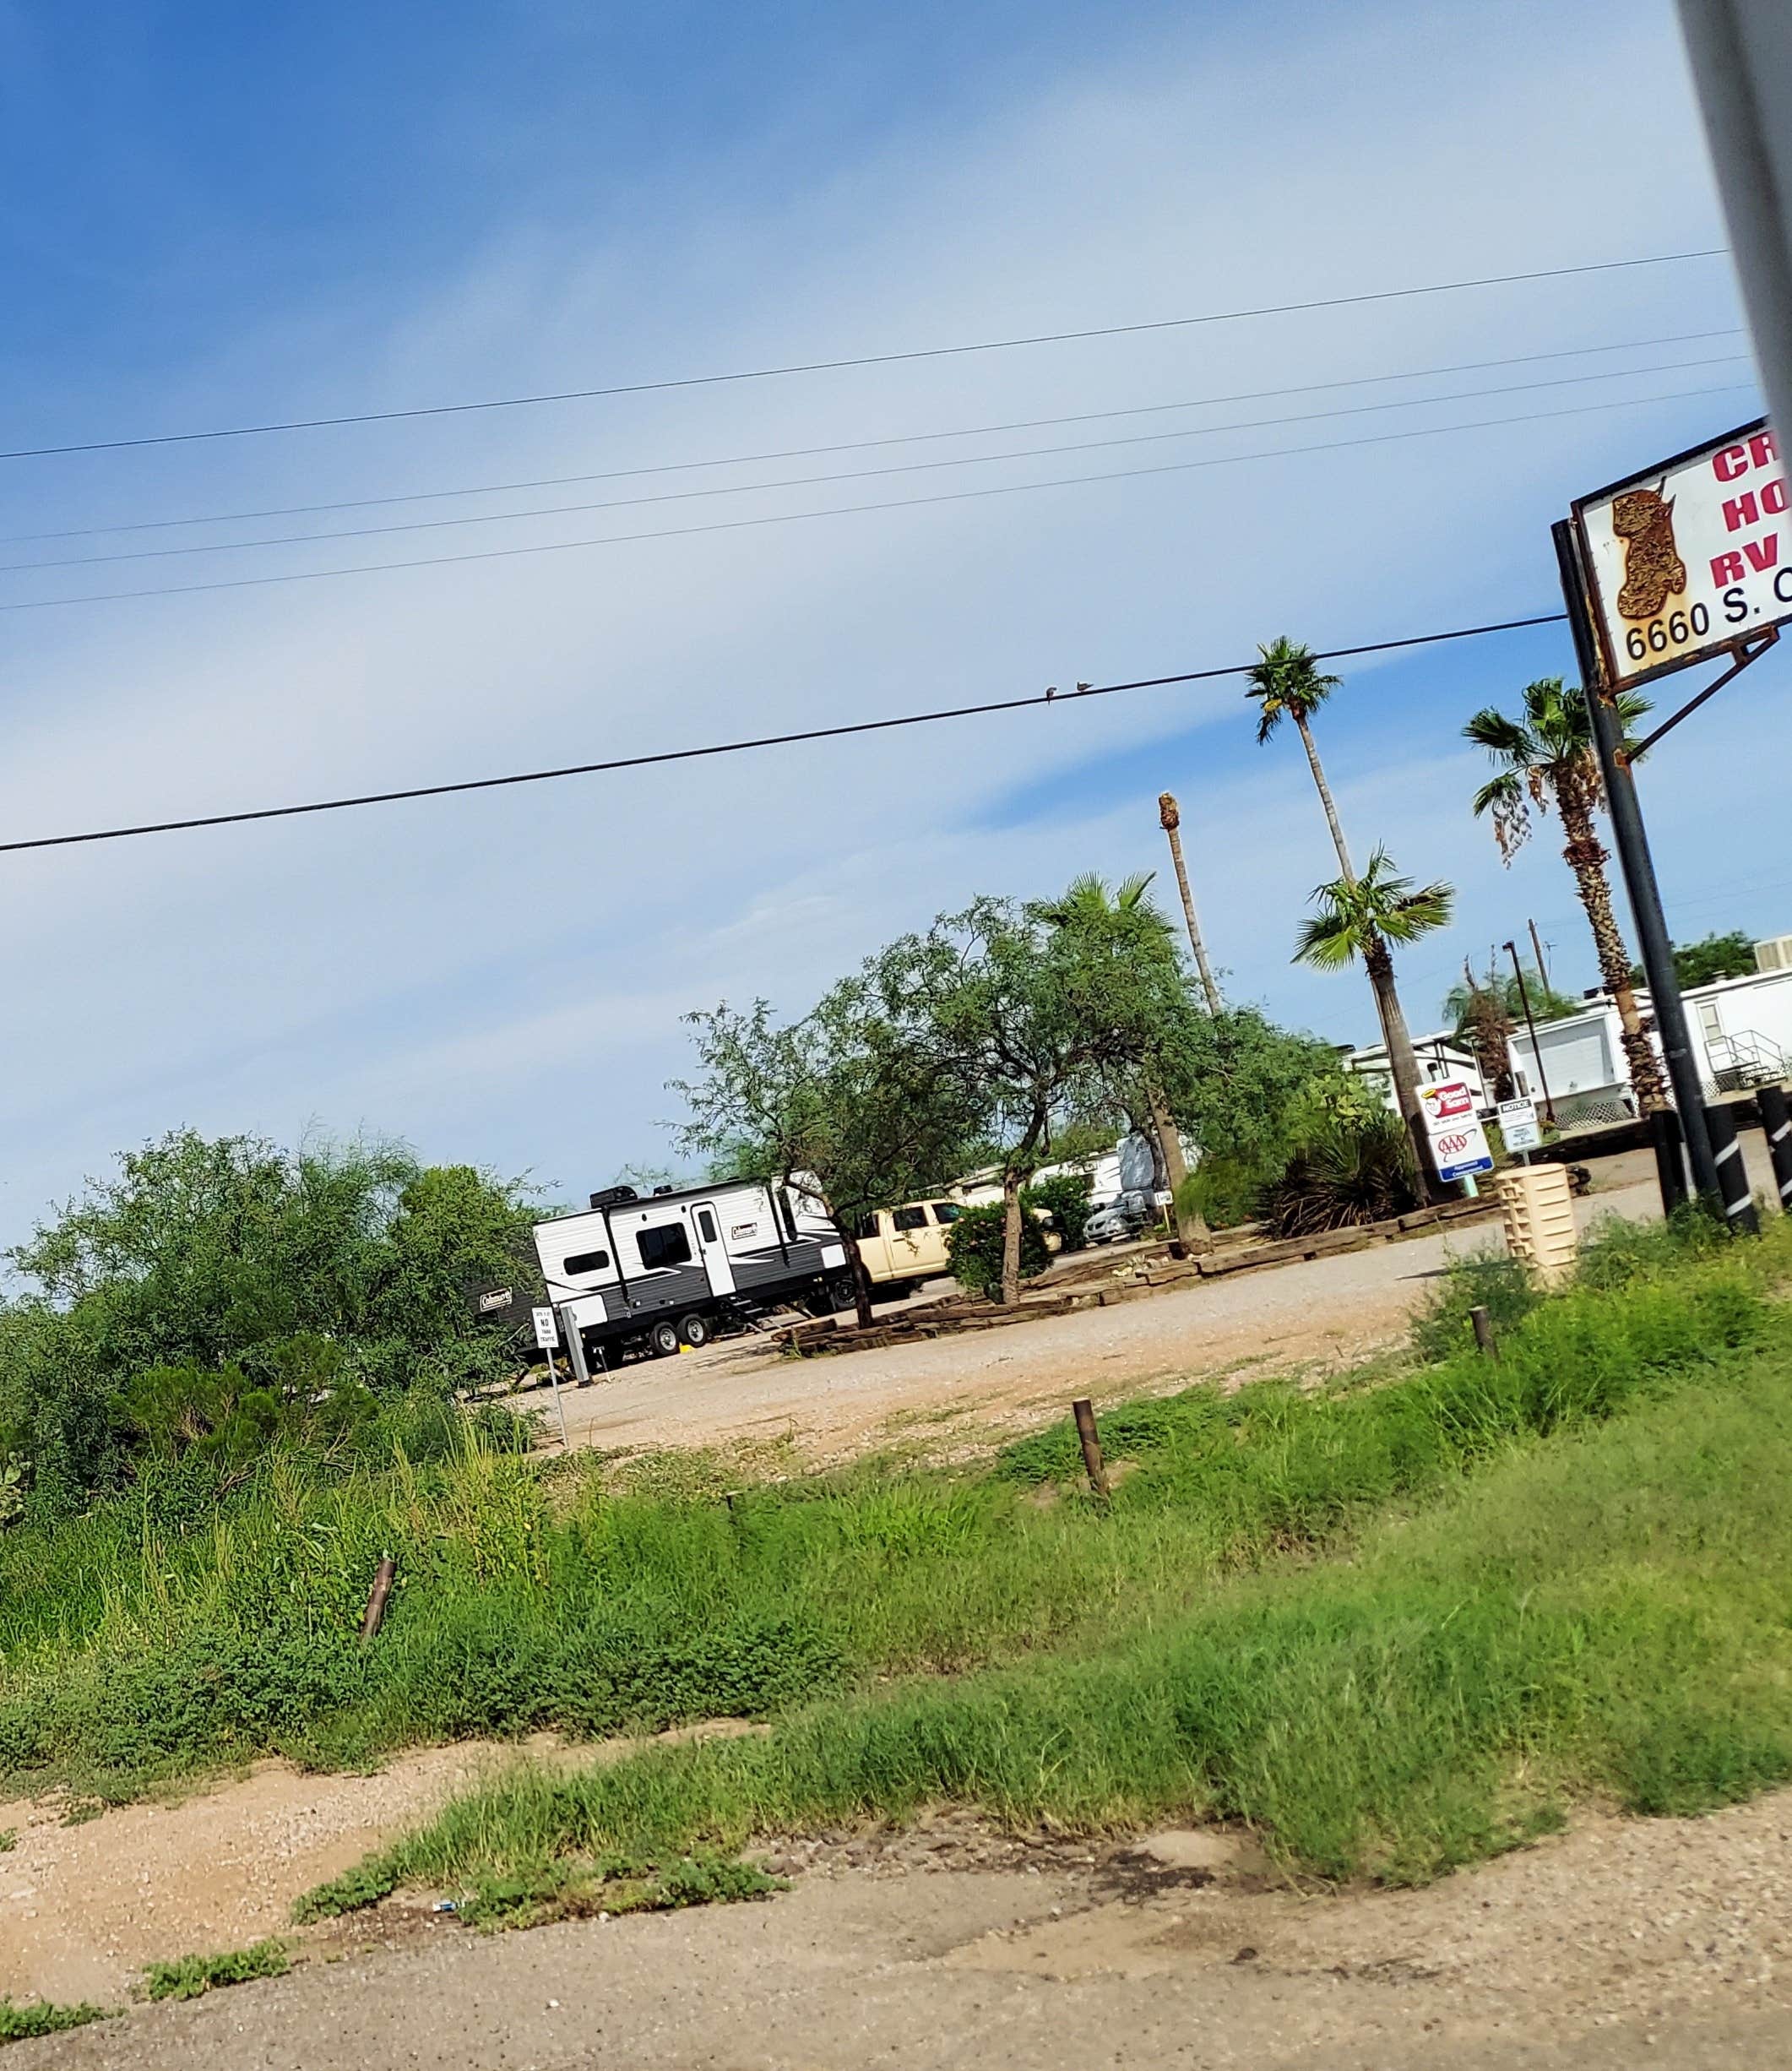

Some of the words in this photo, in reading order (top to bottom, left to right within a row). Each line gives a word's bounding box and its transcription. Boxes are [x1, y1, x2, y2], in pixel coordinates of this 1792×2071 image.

[1709, 532, 1778, 589] RV
[1626, 603, 1709, 660] 6660
[1723, 587, 1760, 622] S.
[1438, 1086, 1468, 1101] Good
[1445, 1097, 1469, 1109] Sam
[1502, 1101, 1529, 1112] NOTICE
[1440, 1134, 1466, 1153] AAA
[540, 1318, 549, 1327] NO
